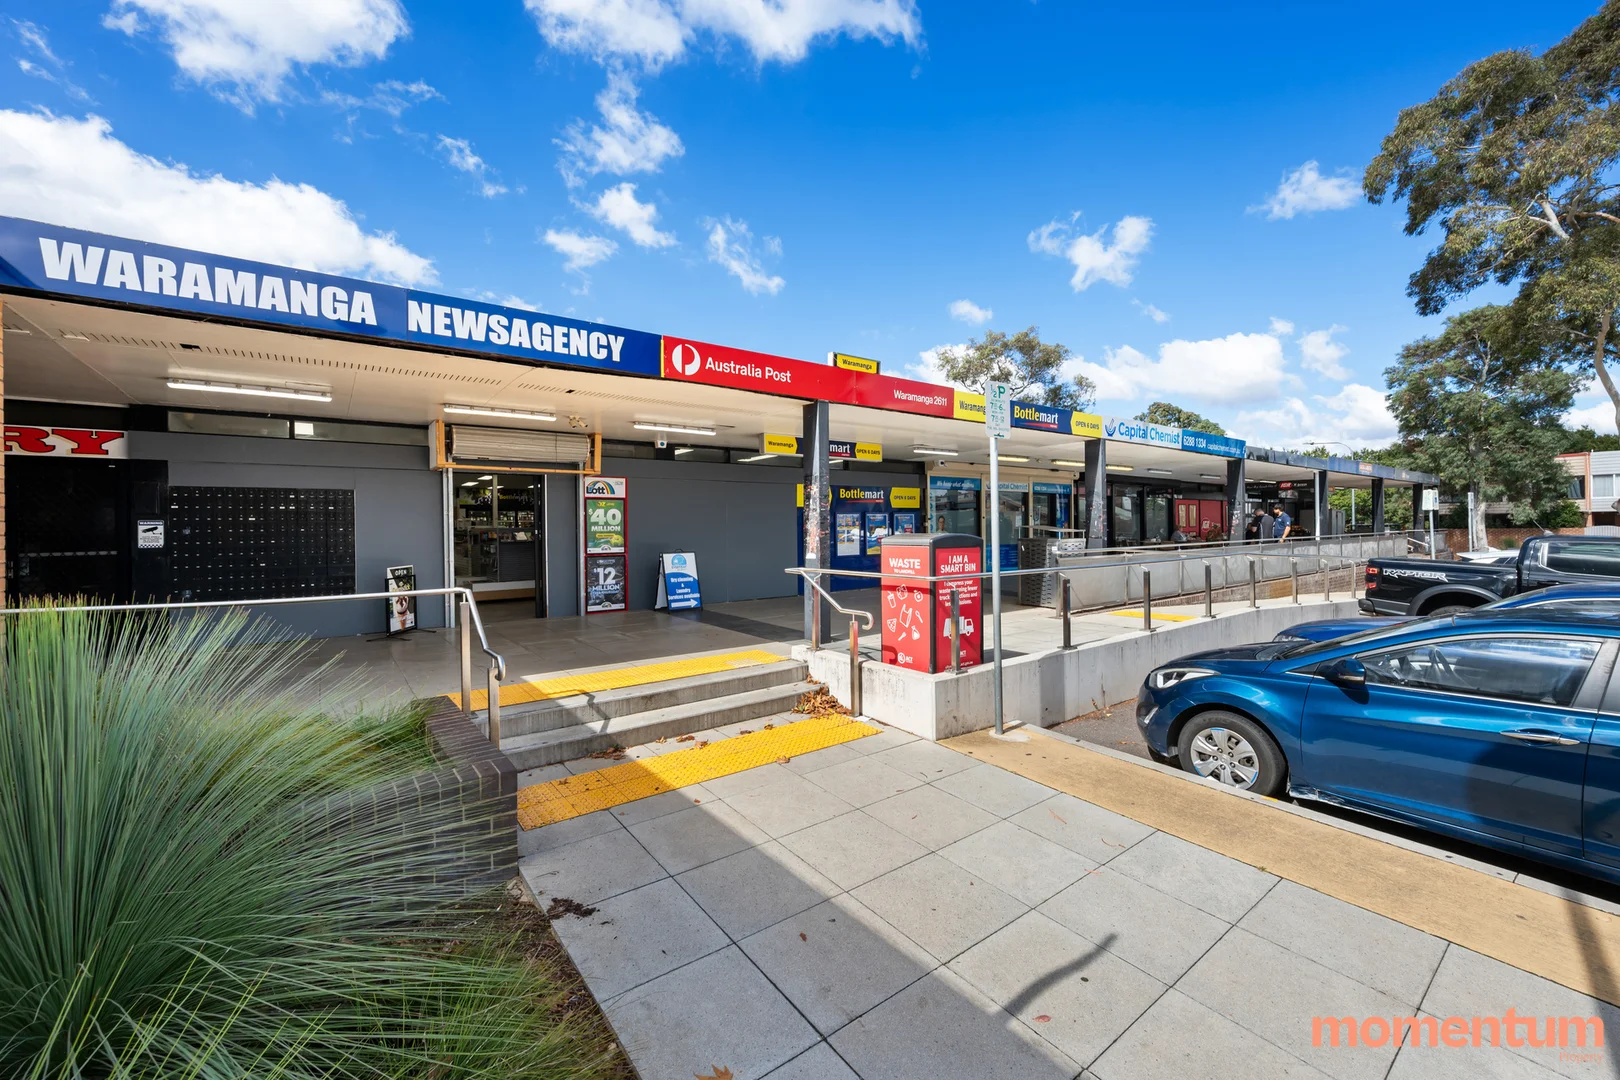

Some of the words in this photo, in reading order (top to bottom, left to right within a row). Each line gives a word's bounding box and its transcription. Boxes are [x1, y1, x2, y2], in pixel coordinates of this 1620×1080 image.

[38, 237, 378, 326] WARAMANGA
[407, 299, 625, 362] NEWSAGENCY
[705, 356, 762, 379] Australia
[765, 366, 792, 383] Post
[842, 358, 873, 370] Waramanga
[893, 389, 933, 406] Waramanga
[934, 395, 948, 406] 2611
[959, 400, 986, 415] Waramang
[1014, 405, 1058, 424] Bottlemart
[1118, 422, 1148, 440] Capital
[1149, 427, 1180, 445] Chemist
[768, 440, 794, 448] Waramanga
[840, 488, 884, 499] Bottlemart
[588, 508, 622, 526] $40
[888, 558, 921, 569] WASTE
[948, 556, 951, 564] I
[952, 555, 962, 564] AM
[940, 564, 963, 574] SMART
[964, 563, 976, 572] BIN
[1382, 568, 1449, 582] RAPTOR
